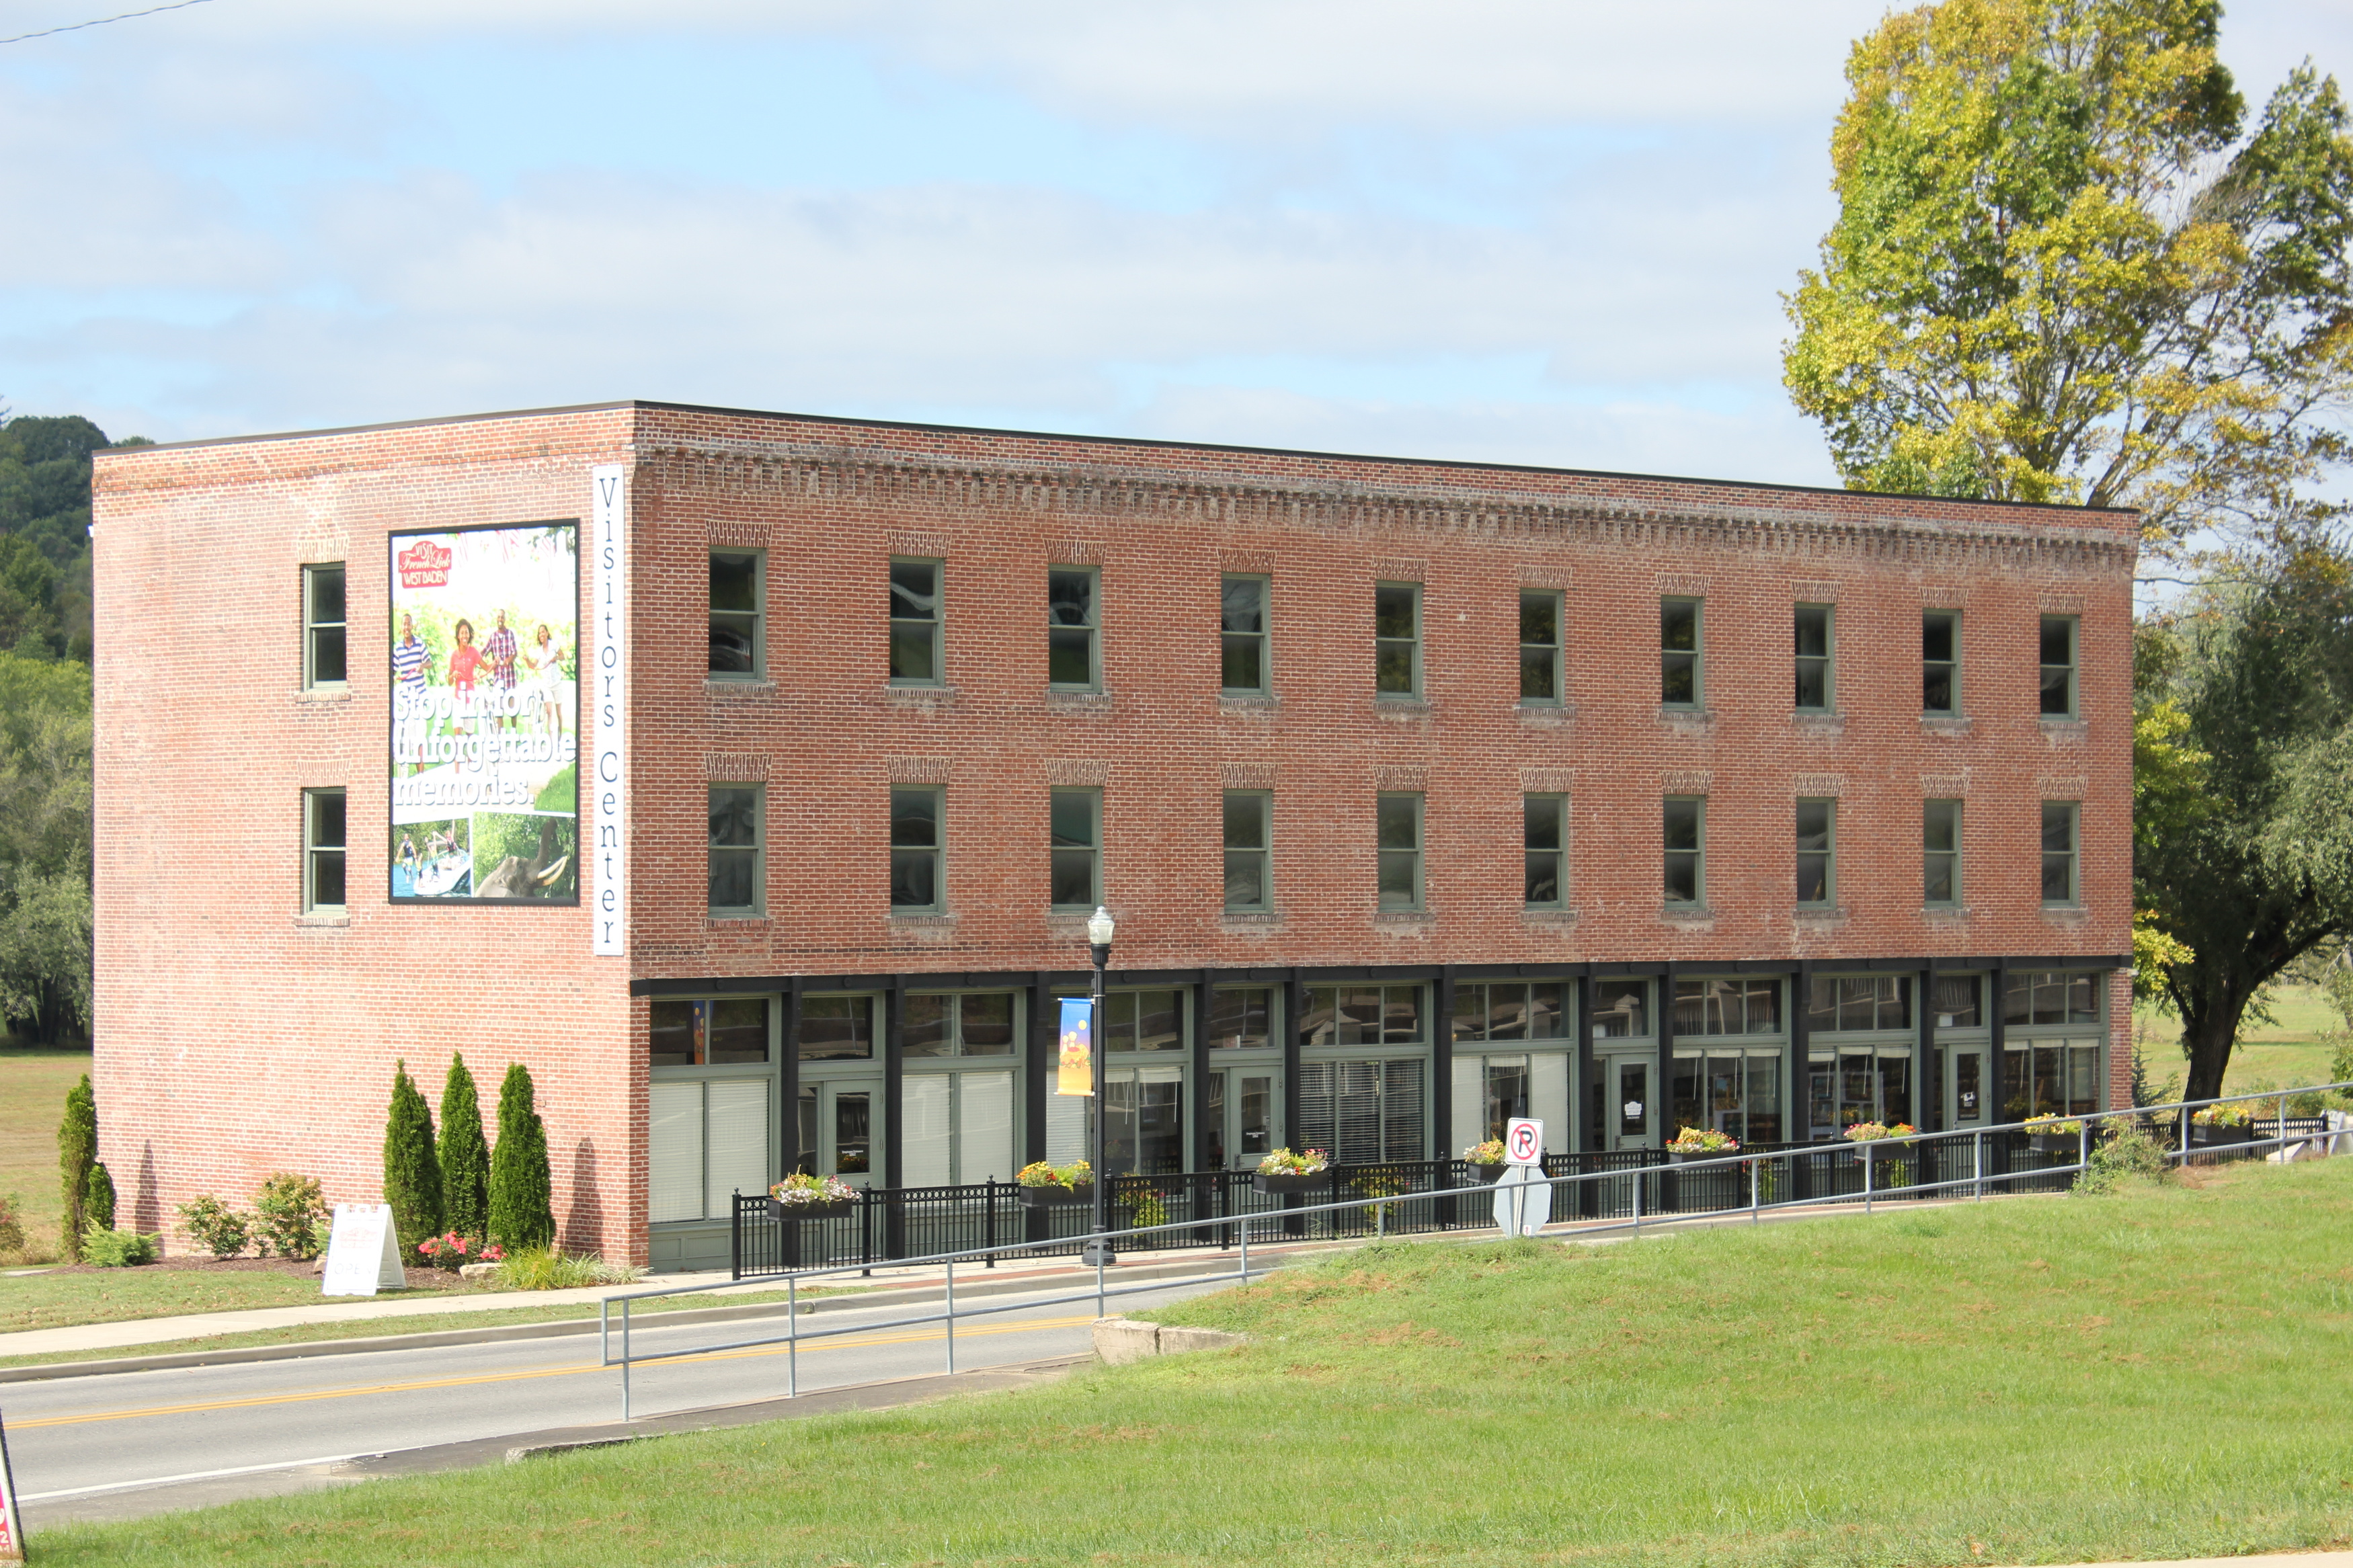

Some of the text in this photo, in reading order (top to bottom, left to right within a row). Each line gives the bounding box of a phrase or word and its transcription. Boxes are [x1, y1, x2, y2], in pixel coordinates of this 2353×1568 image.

[399, 550, 450, 571] French Lick
[415, 542, 434, 559] VISIT
[403, 570, 447, 585] WEST BADEN
[393, 678, 537, 727] Stop in for
[599, 477, 618, 944] Visitors Center
[394, 768, 535, 806] memories.
